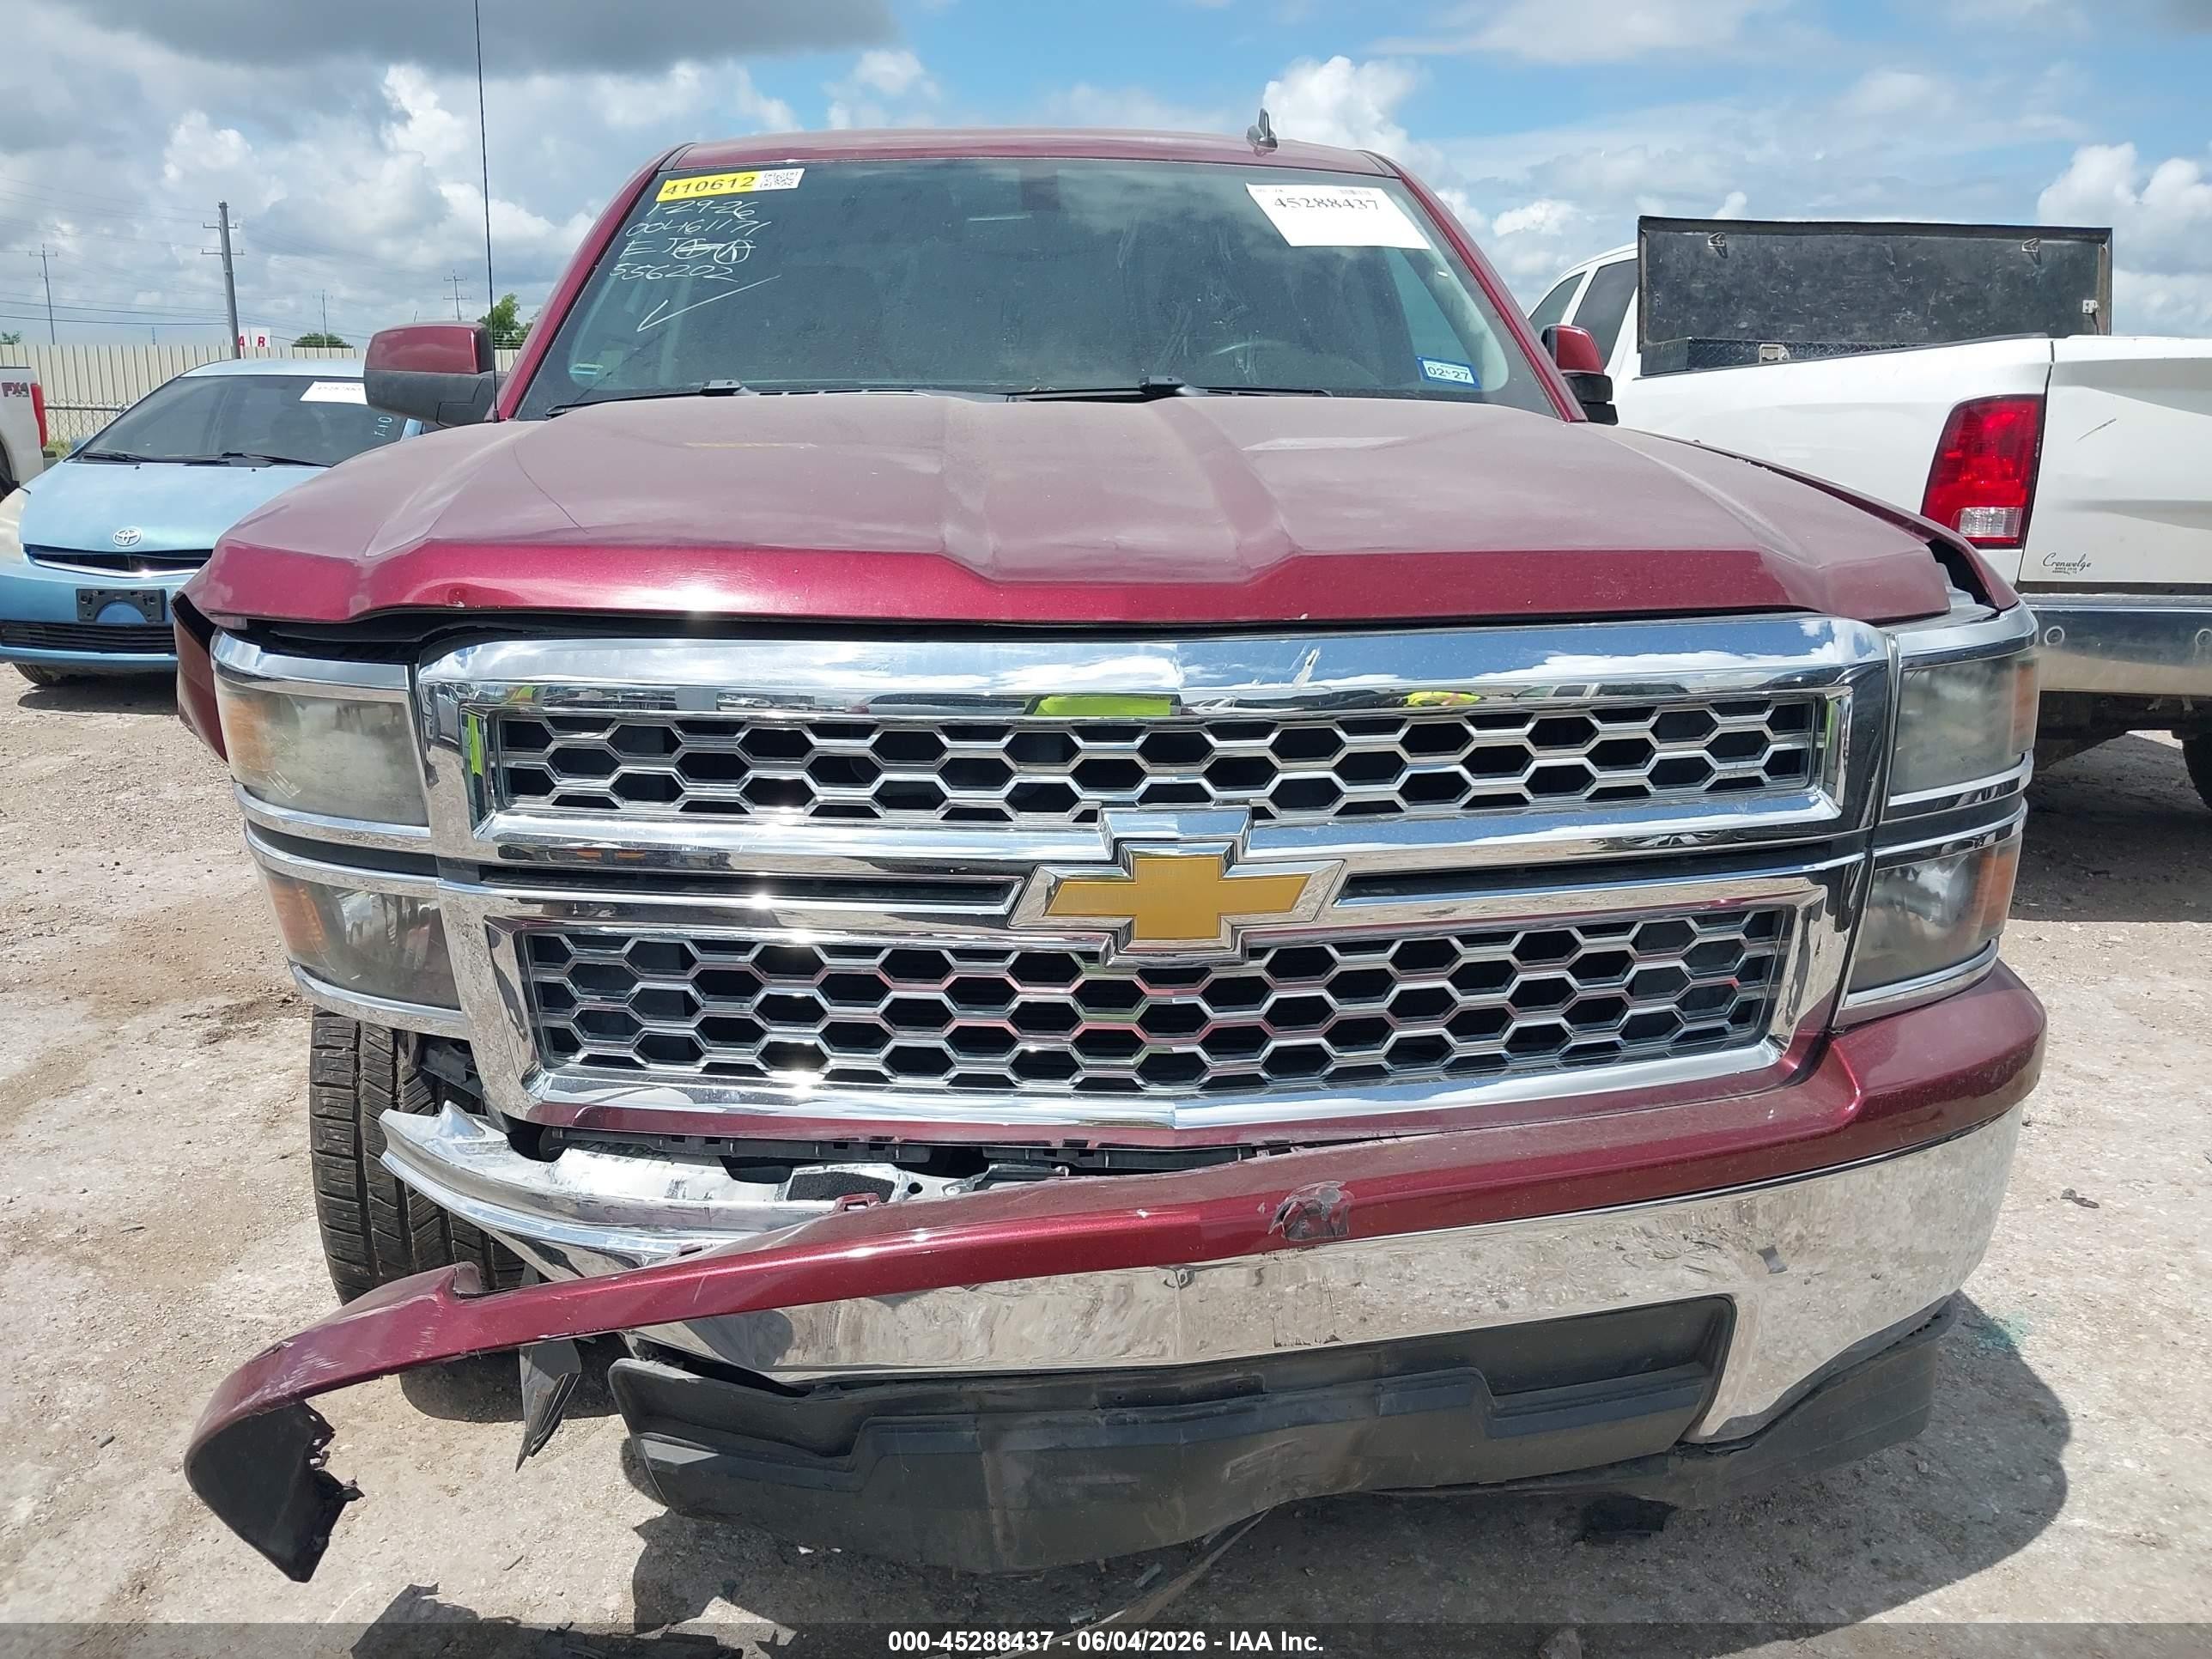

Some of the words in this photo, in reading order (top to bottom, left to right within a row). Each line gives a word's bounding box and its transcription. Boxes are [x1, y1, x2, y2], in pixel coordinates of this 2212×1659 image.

[664, 176, 756, 195] 410612
[1274, 197, 1379, 210] 45288437
[609, 263, 739, 283] 556202
[1, 382, 29, 397] FX4
